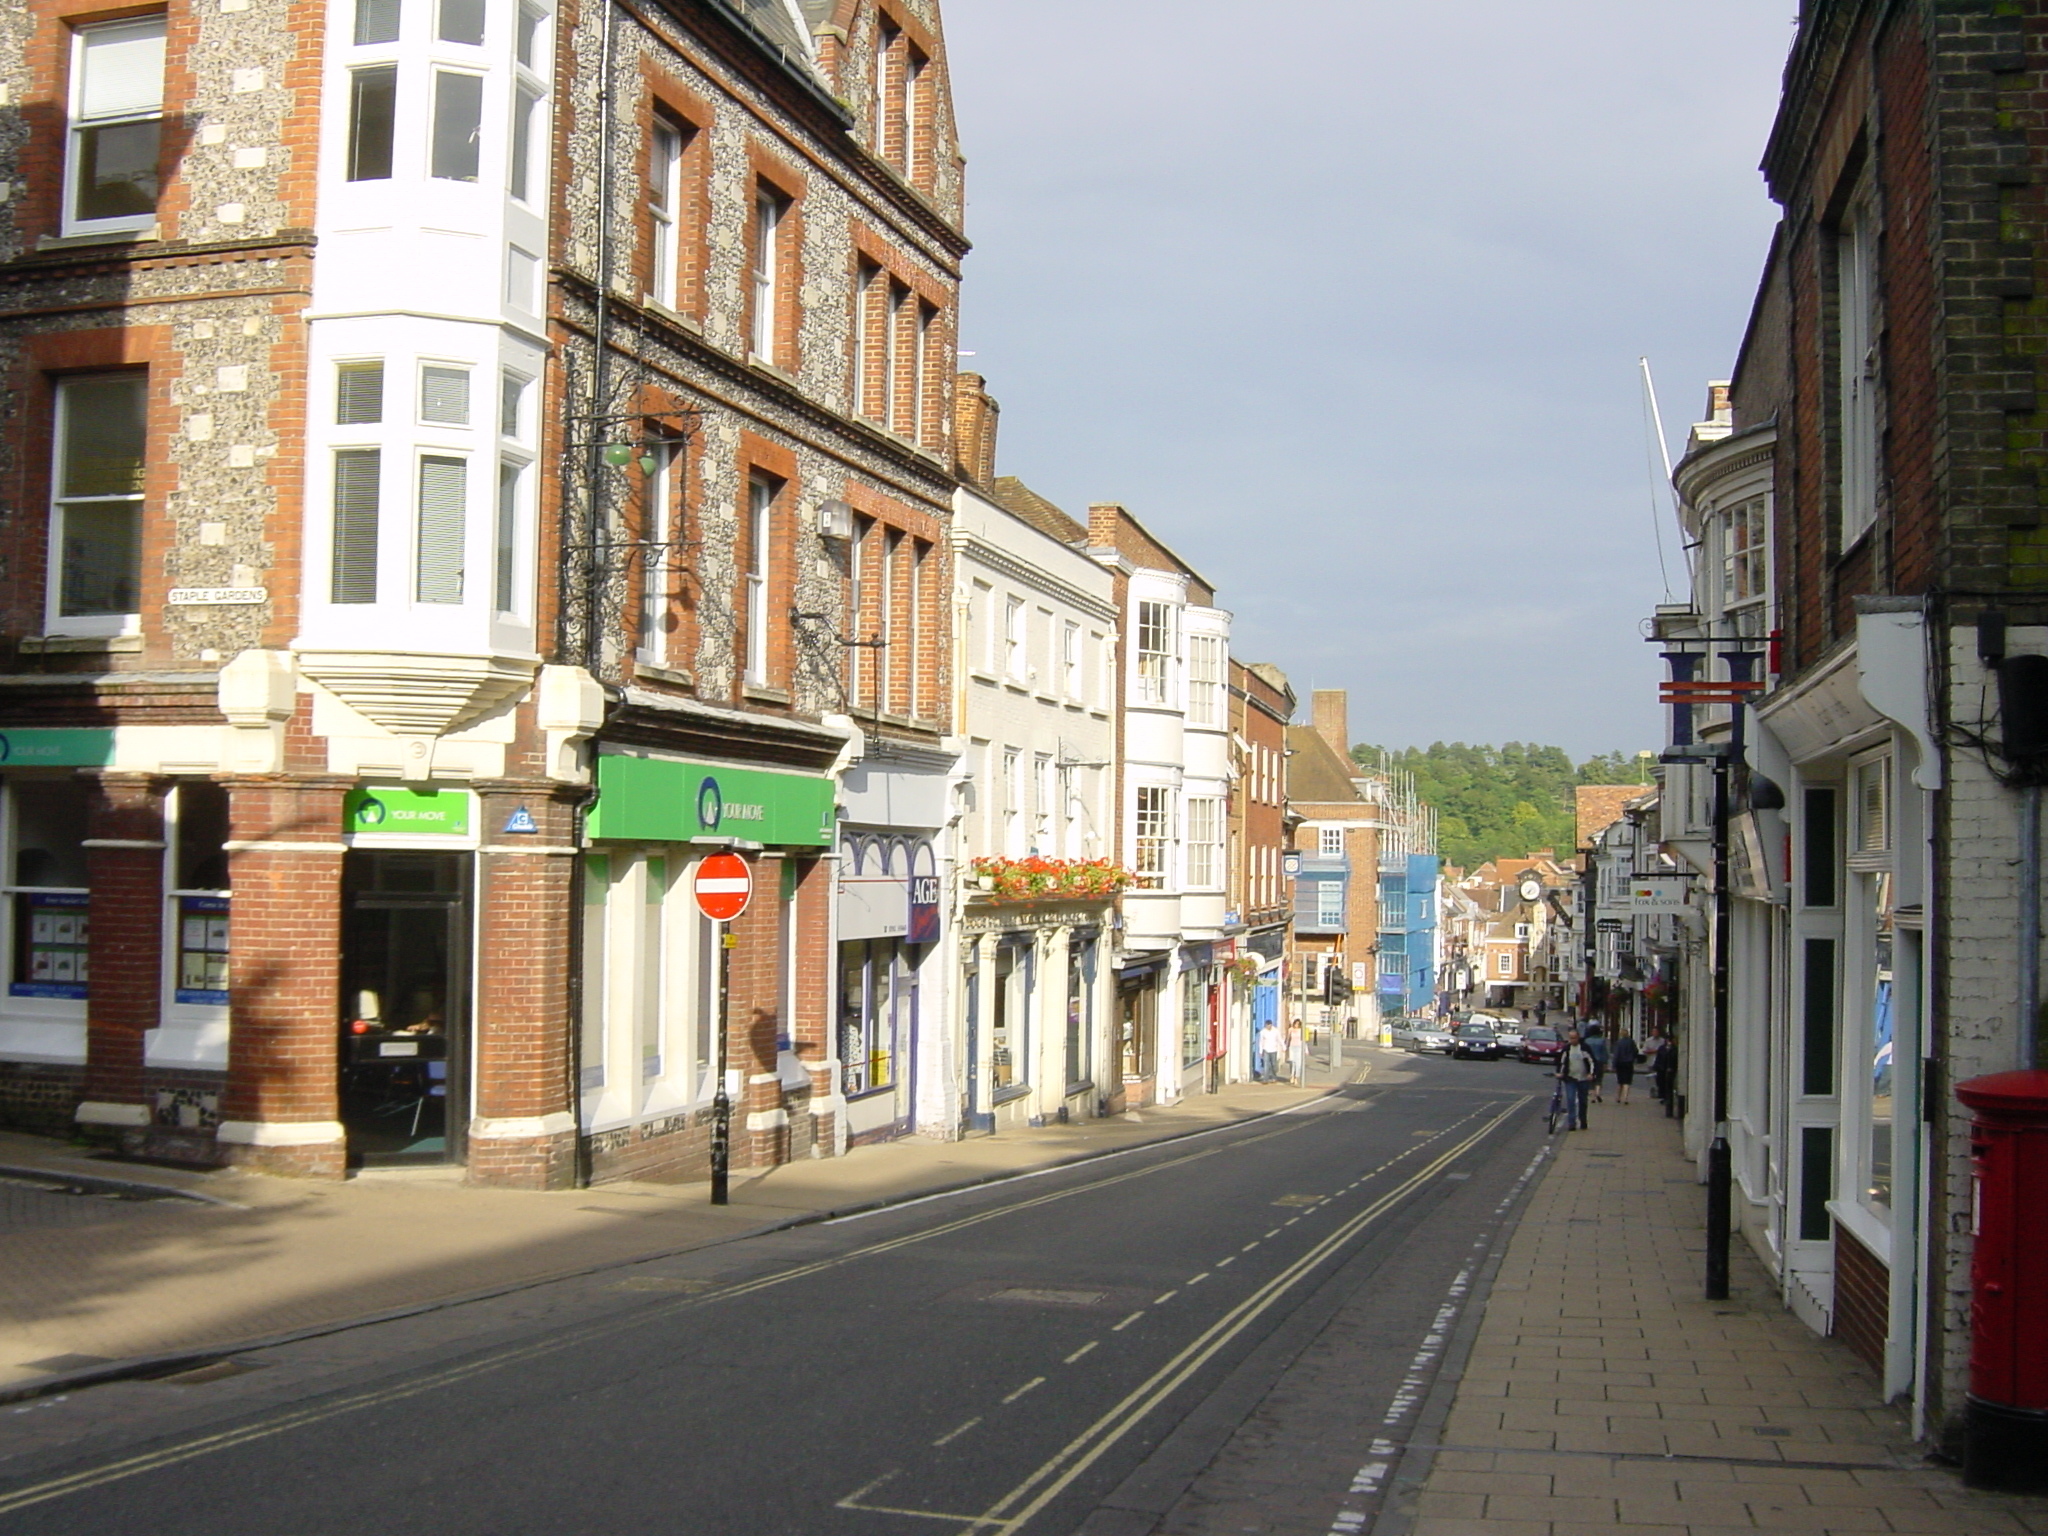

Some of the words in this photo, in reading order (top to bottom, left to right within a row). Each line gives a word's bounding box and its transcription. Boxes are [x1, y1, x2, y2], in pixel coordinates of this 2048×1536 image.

[171, 591, 210, 601] STAPLE
[214, 590, 263, 601] GARDENS
[391, 809, 416, 820] YOUR
[418, 810, 446, 821] MOVE
[723, 802, 741, 819] YOUR
[741, 803, 764, 820] MOVE
[912, 878, 938, 904] AGE
[1634, 897, 1650, 906] fox
